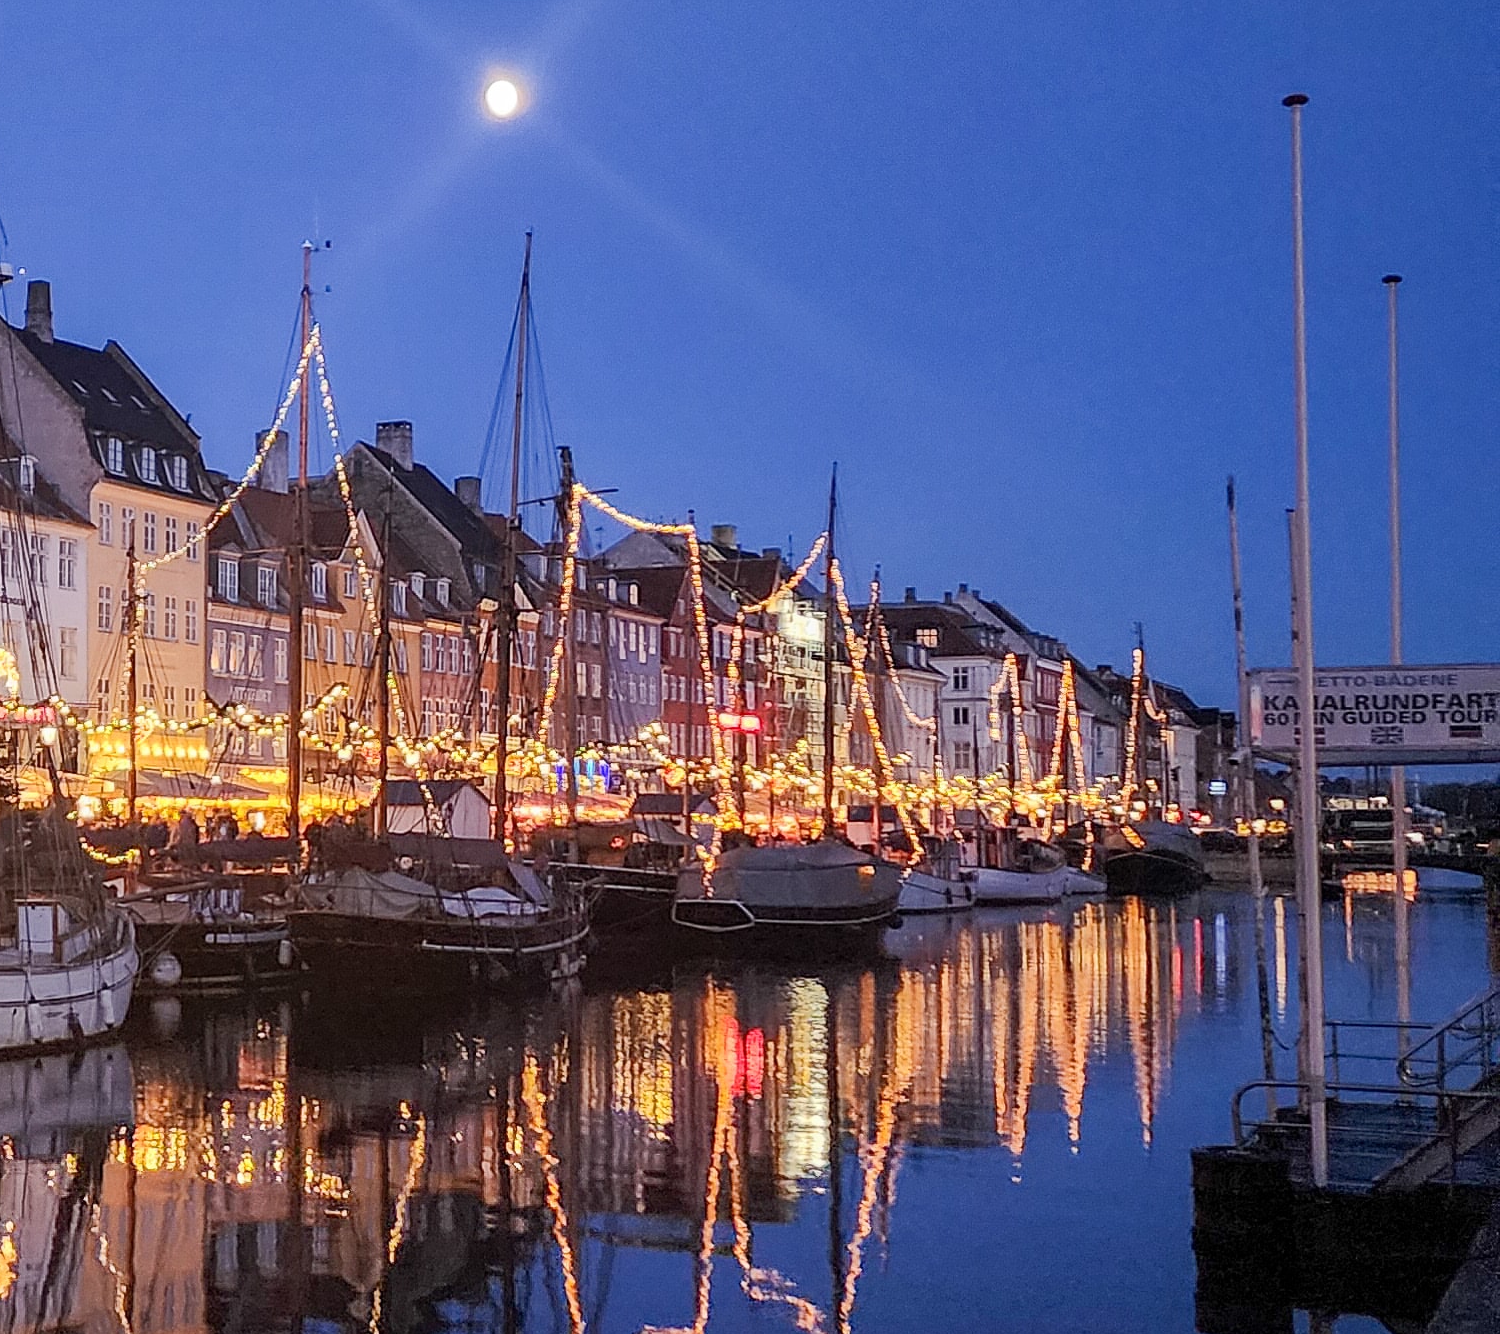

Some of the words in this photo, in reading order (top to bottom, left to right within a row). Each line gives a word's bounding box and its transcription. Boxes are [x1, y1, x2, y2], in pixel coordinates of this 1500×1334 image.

[1315, 673, 1458, 687] ETTO-BÅDENE
[1263, 692, 1500, 710] KAALRUNDFART
[1264, 713, 1289, 725] 60
[1342, 710, 1426, 725] GUIDED
[1436, 709, 1497, 724] TOUR
